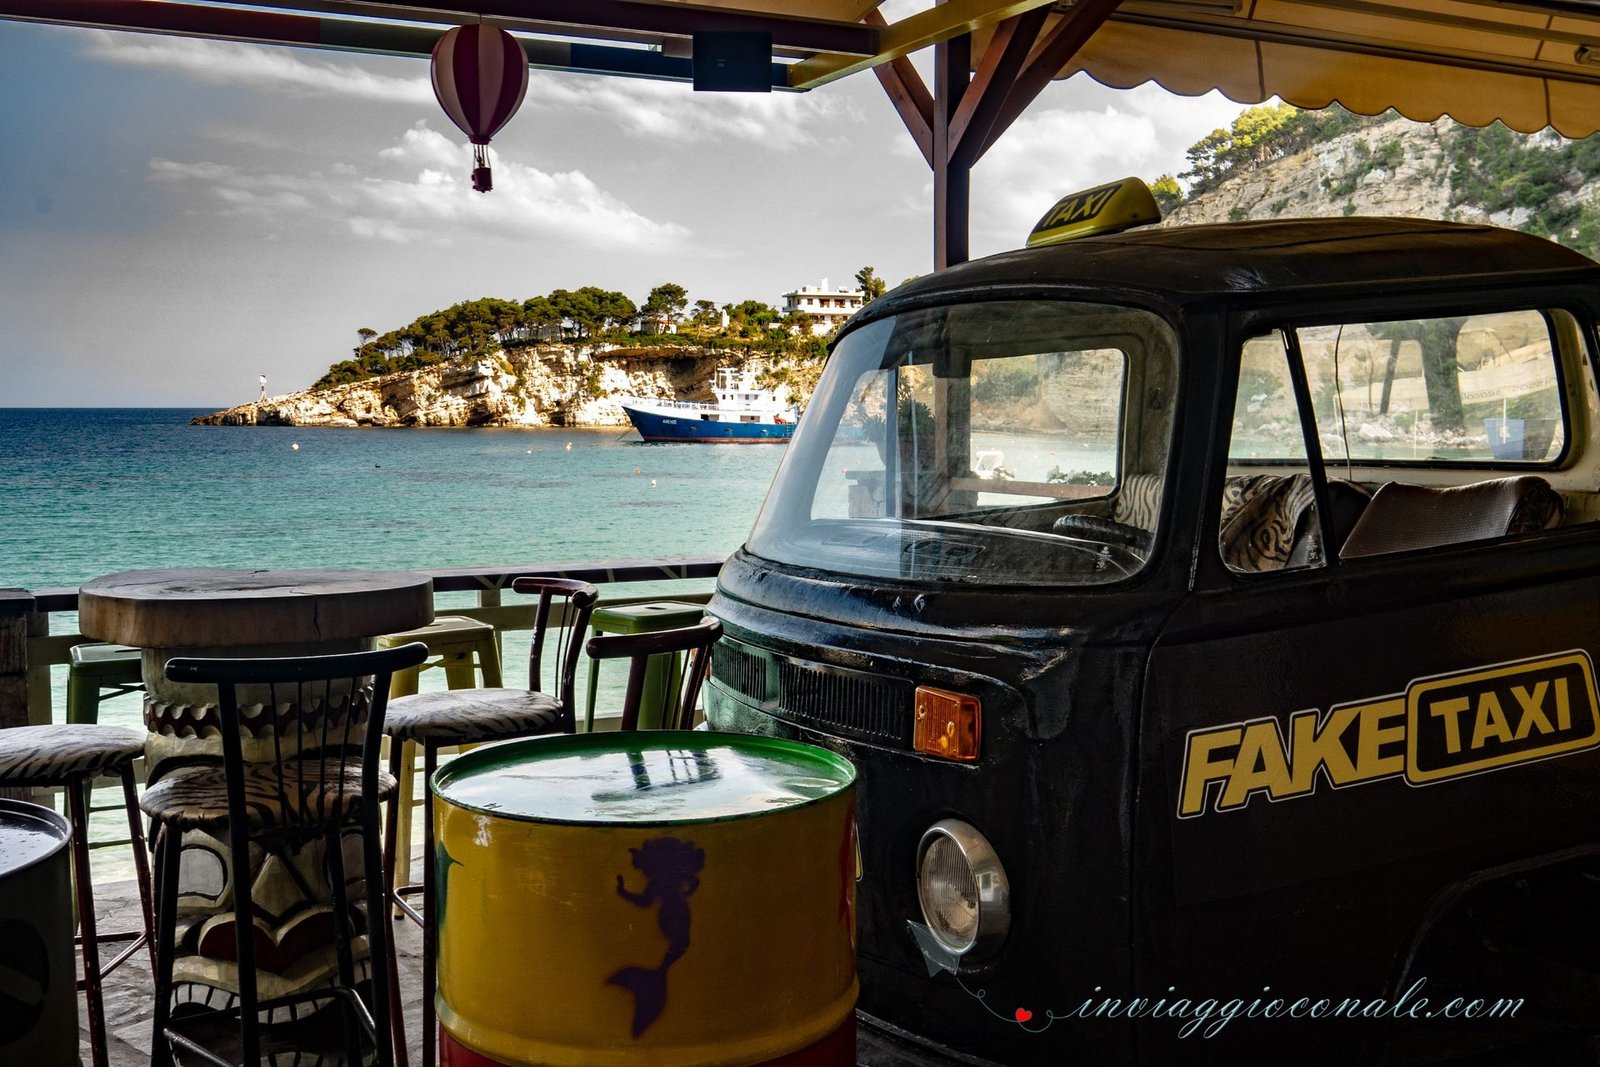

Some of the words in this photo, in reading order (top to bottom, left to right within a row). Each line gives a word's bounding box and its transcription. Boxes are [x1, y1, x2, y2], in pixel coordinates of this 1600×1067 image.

[1042, 187, 1115, 228] TAXI
[1181, 695, 1407, 815] FAKE
[1429, 676, 1573, 755] TAXI
